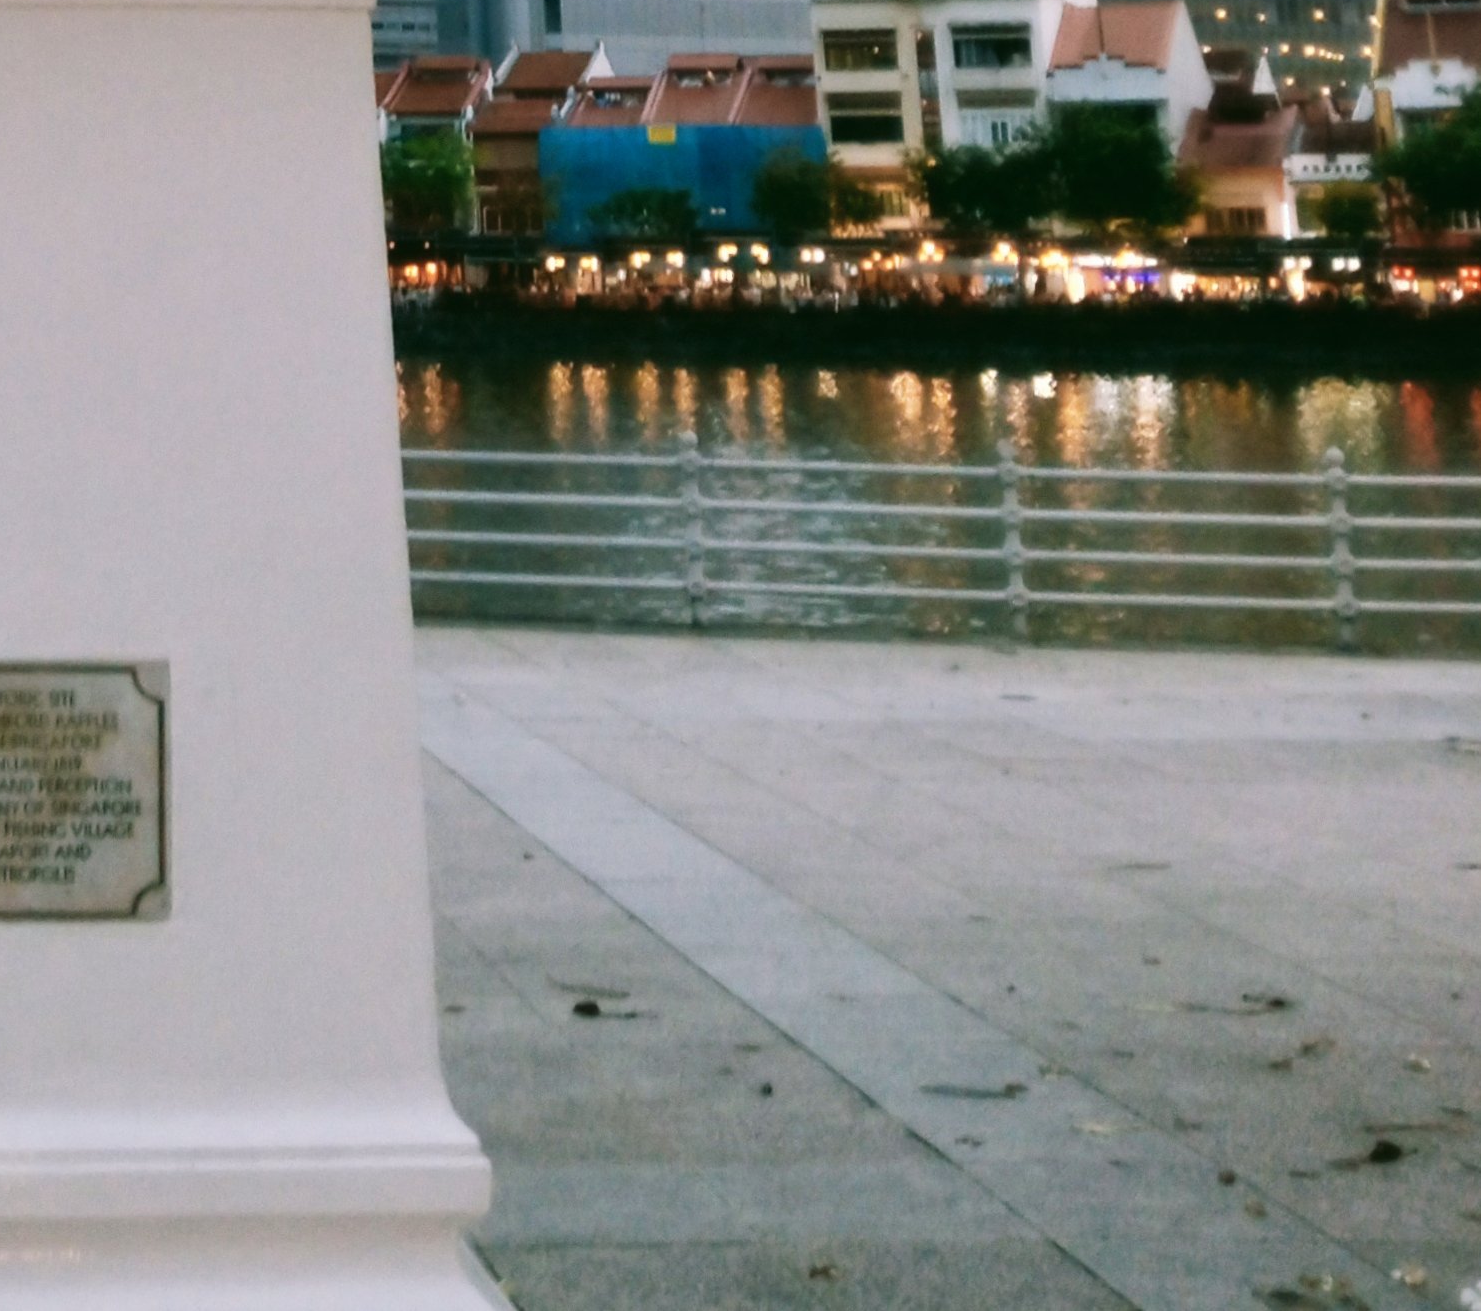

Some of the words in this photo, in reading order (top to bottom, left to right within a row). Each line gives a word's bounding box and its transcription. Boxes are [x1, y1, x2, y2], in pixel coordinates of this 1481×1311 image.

[51, 800, 141, 817] SINGAPORE
[71, 822, 135, 839] VILLAGE
[55, 843, 92, 861] AND
